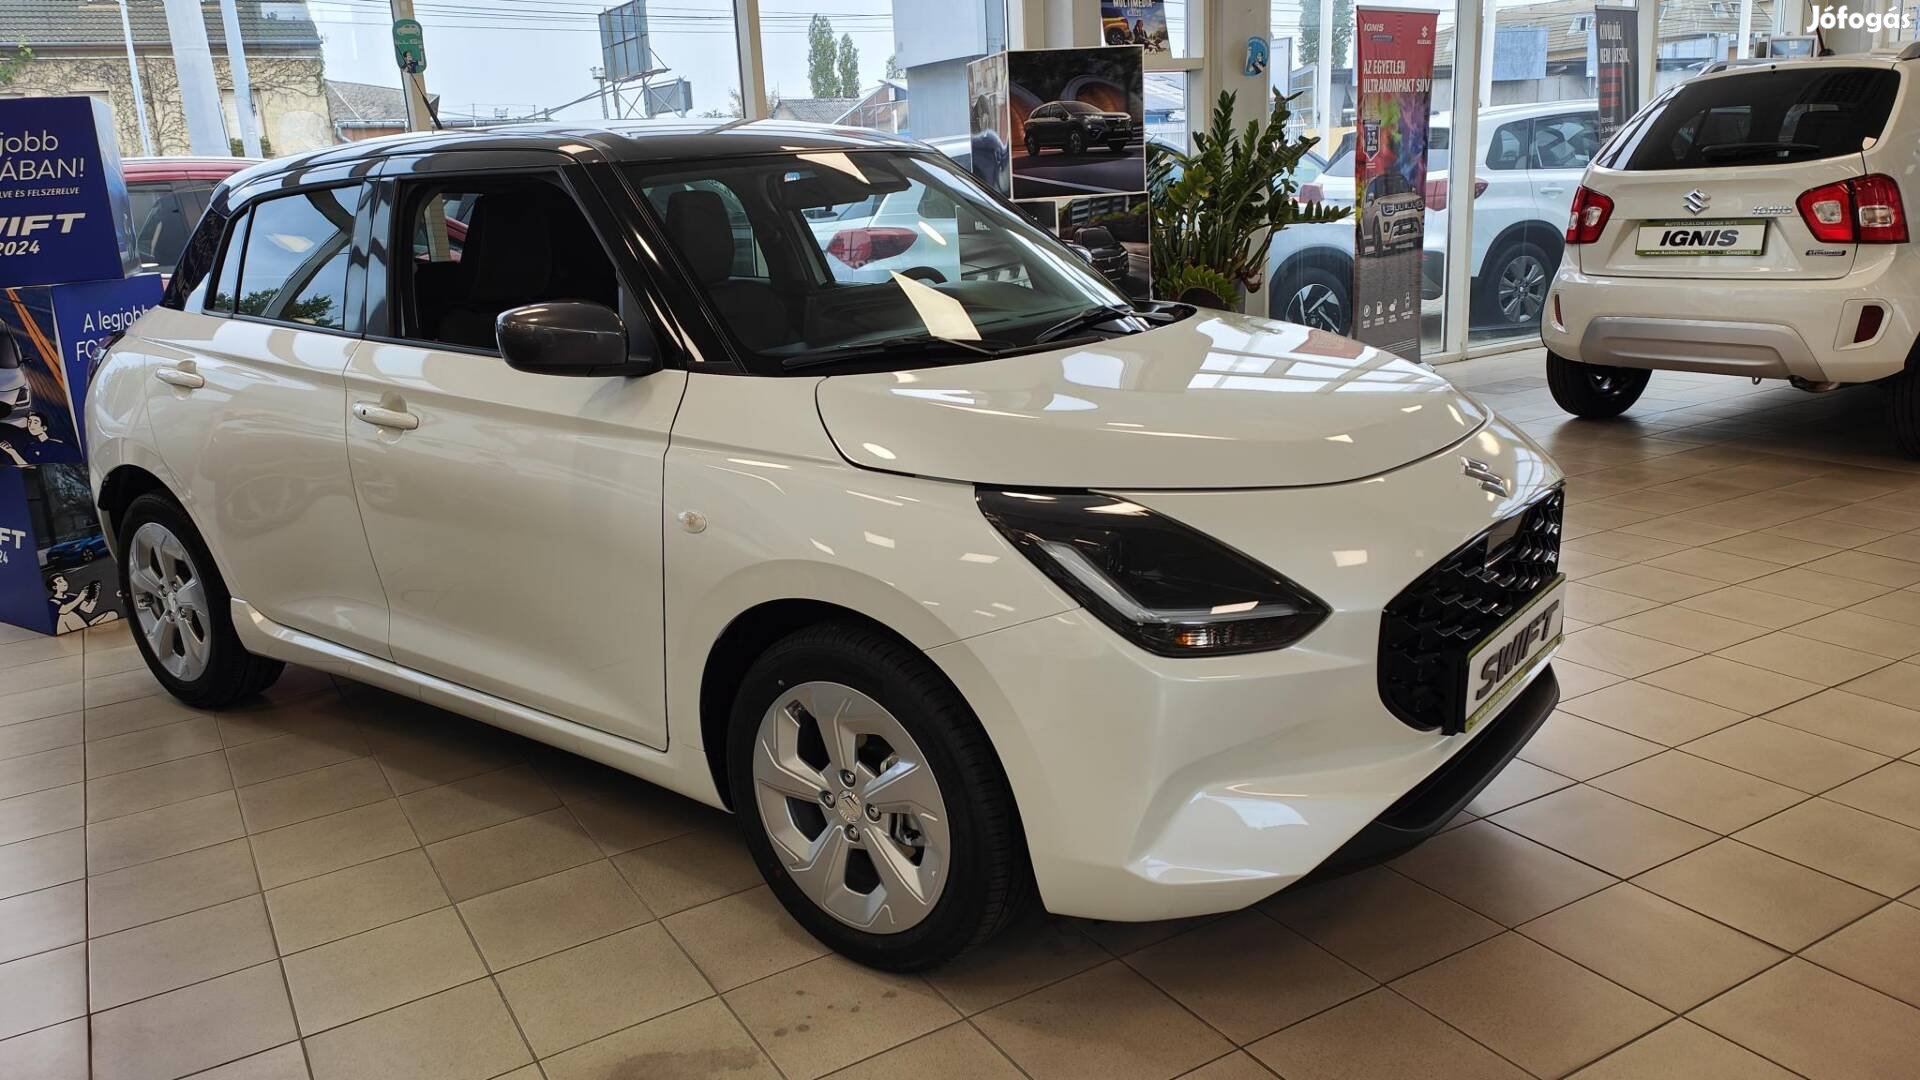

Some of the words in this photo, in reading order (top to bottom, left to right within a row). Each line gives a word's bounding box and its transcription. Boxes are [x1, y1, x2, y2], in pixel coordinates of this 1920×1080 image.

[1363, 23, 1385, 32] IGNIS
[1363, 59, 1373, 74] AZ
[1373, 59, 1406, 75] EGYETLEN
[1363, 78, 1415, 93] ULTRAKOMPAKT
[1416, 78, 1431, 92] SUV
[27, 186, 80, 197] FELSZERELVE
[1660, 229, 1739, 247] IGNIS
[83, 313, 95, 333] A
[1475, 600, 1559, 701] SWIFT
